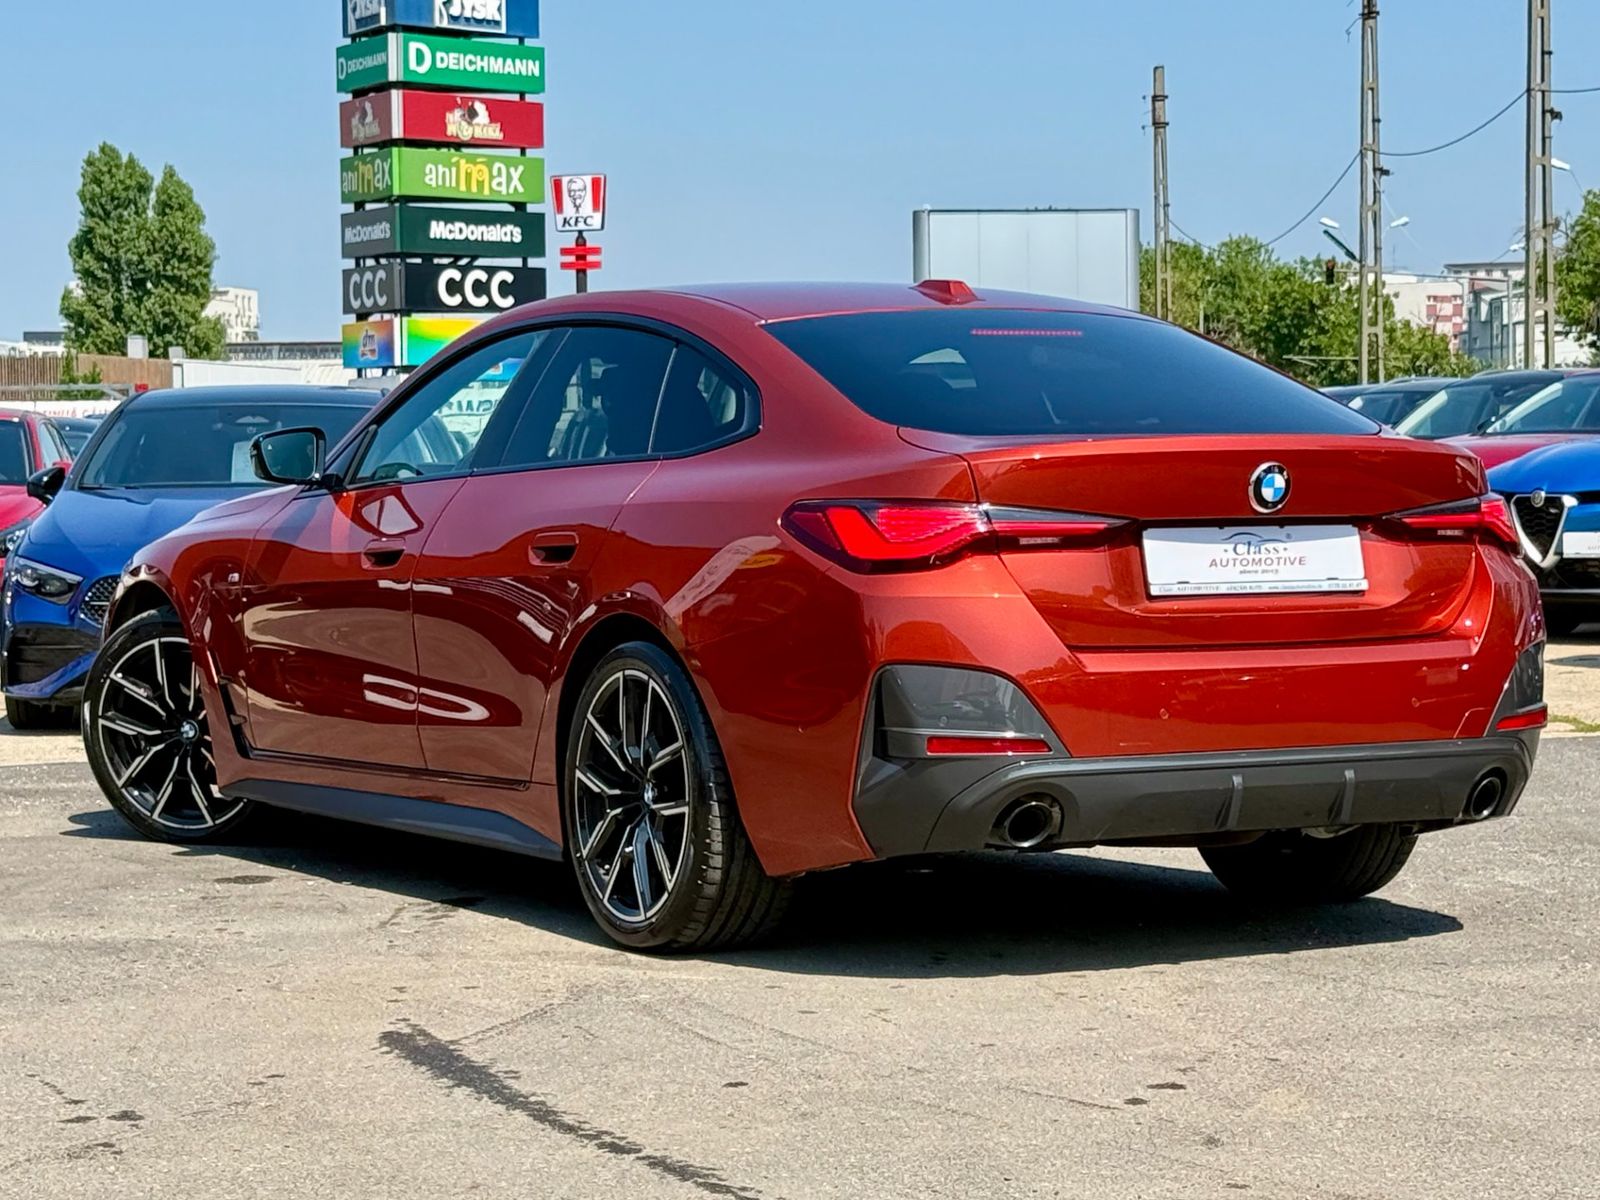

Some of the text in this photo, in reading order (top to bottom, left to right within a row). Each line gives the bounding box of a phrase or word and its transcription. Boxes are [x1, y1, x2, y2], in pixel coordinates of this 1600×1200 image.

[449, 0, 502, 21] JYSK
[347, 52, 388, 73] DEICHMANN
[436, 50, 540, 77] DEICHMANN
[342, 157, 392, 194] animax
[424, 157, 525, 195] animax
[344, 221, 391, 244] McDonald's
[429, 220, 522, 243] McDonald's
[561, 215, 594, 228] KFC
[350, 268, 388, 310] CCC
[437, 267, 515, 308] CCC
[362, 328, 376, 349] dm
[1233, 541, 1280, 556] Class
[1209, 556, 1307, 568] AUTOMOTIVE
